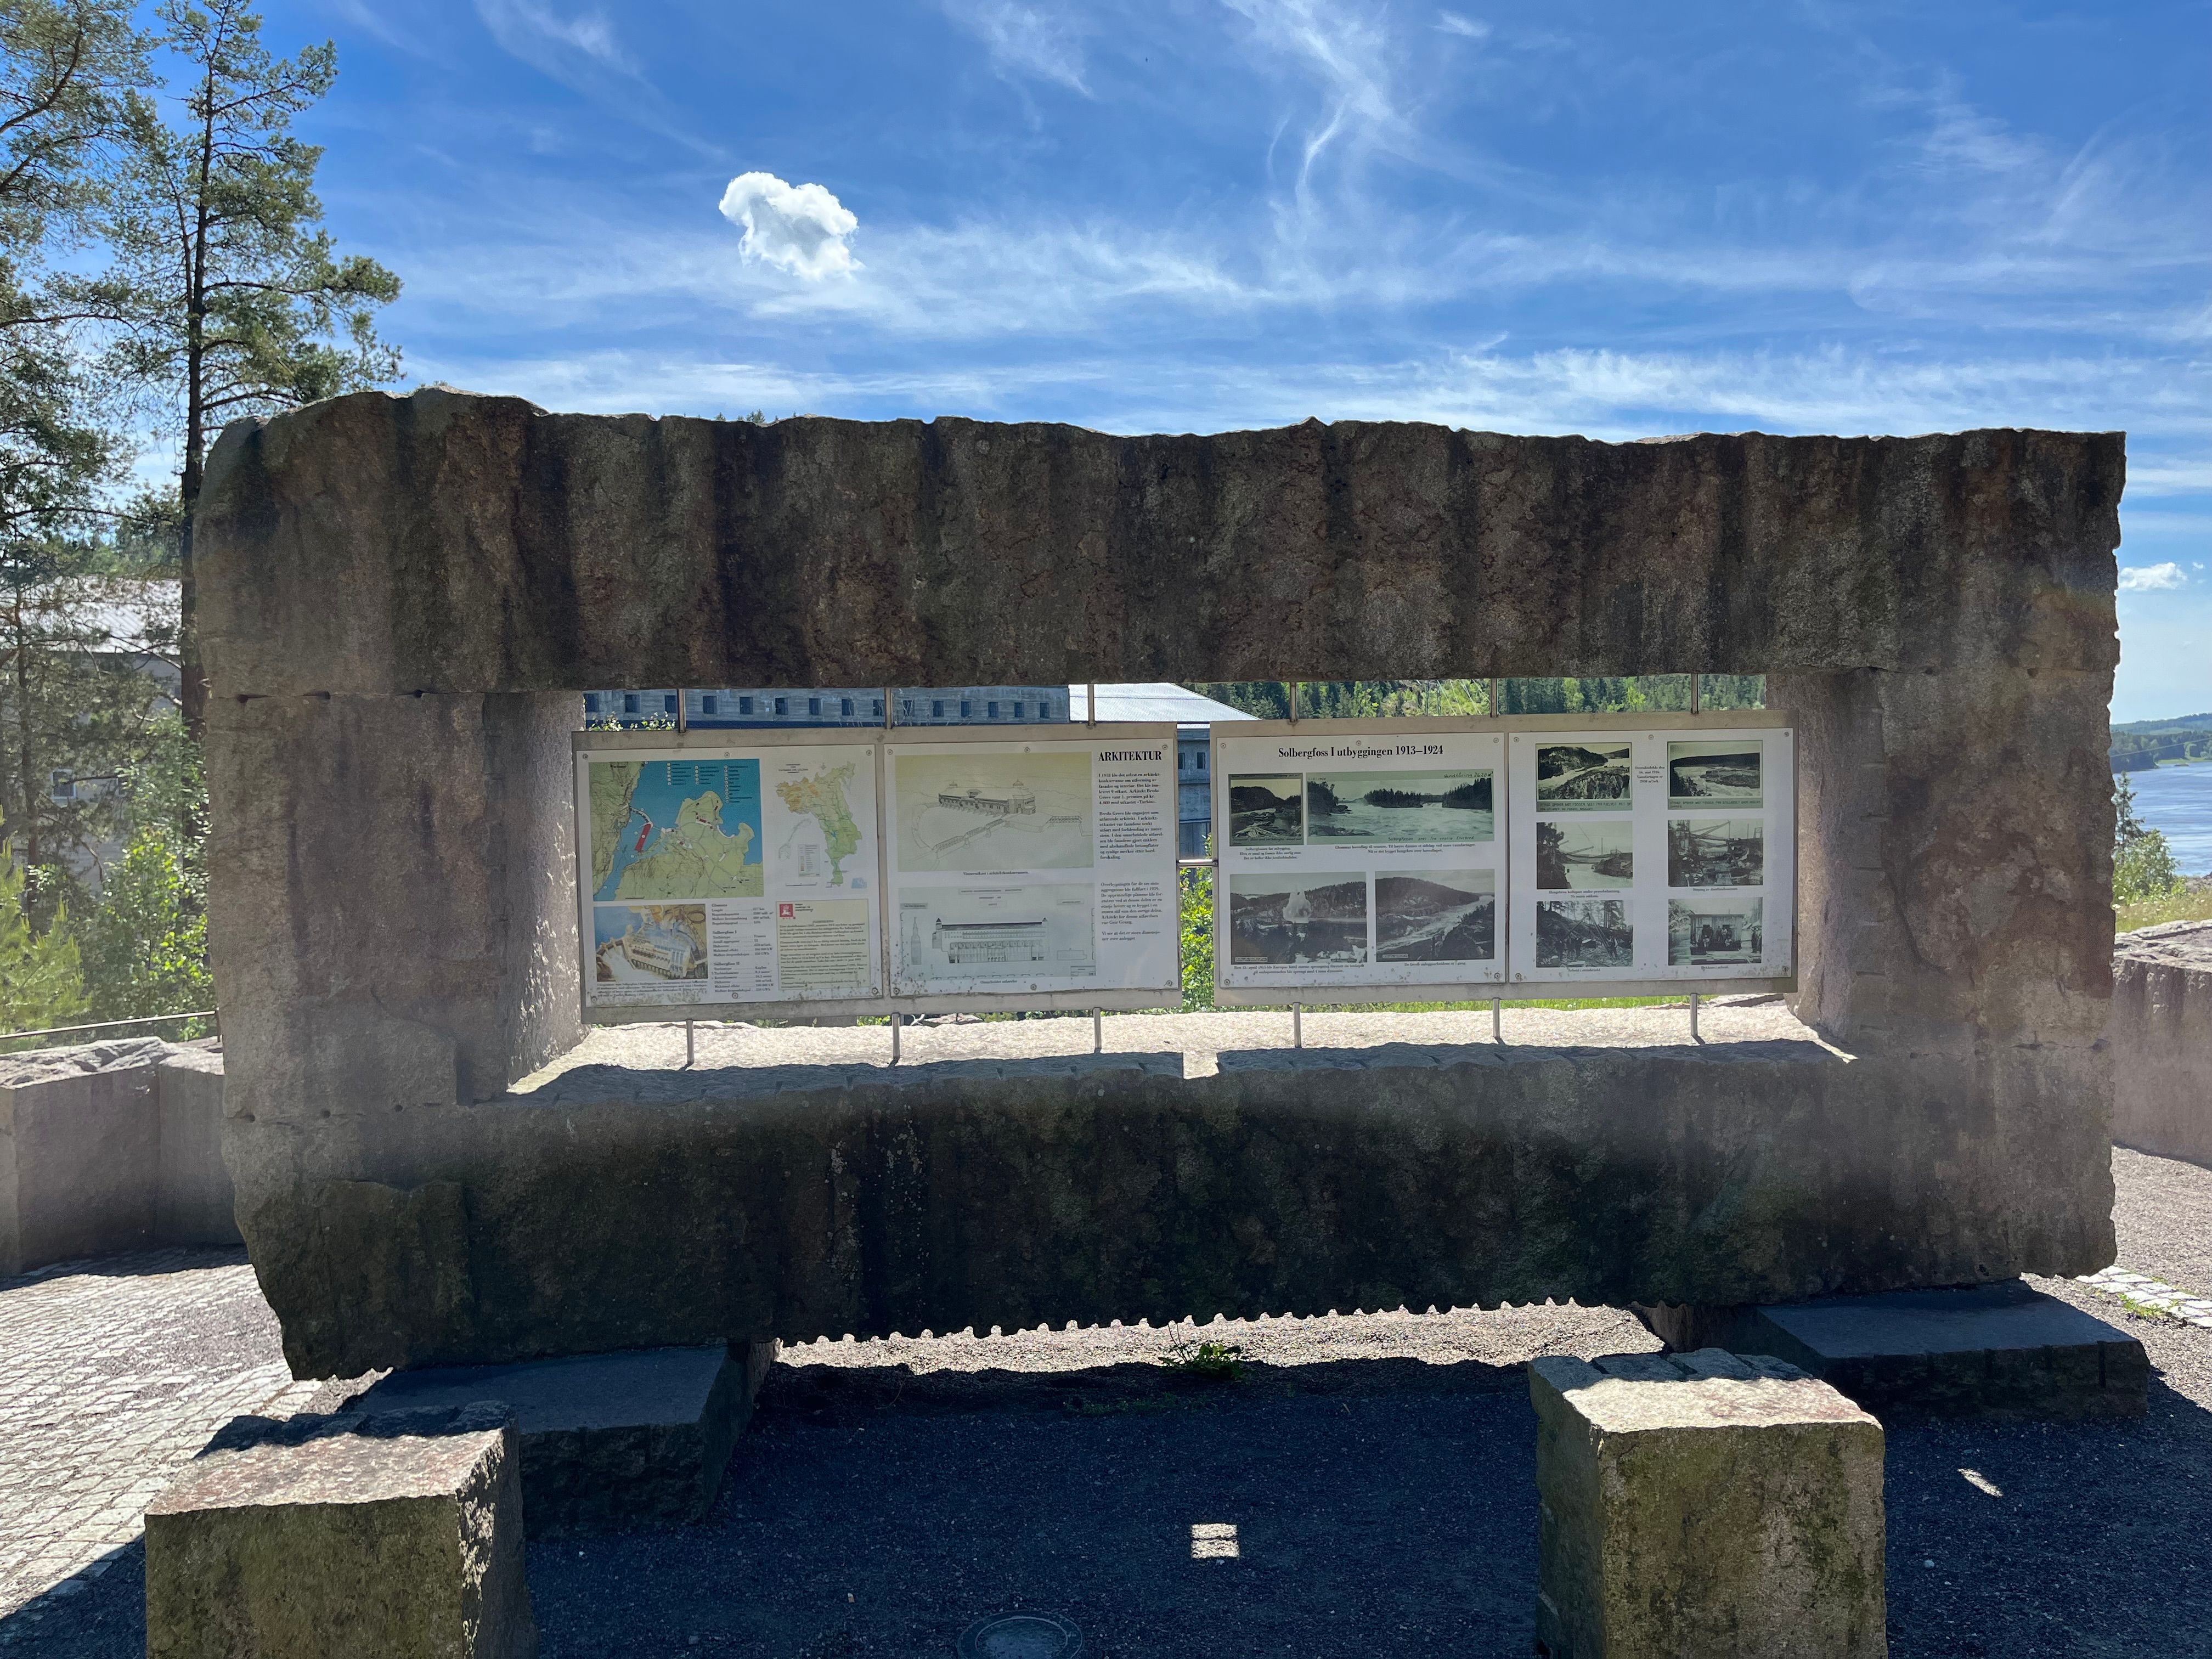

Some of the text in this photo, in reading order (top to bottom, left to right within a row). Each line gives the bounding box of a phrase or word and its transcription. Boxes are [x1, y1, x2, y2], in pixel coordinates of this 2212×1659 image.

[1098, 751, 1161, 761] ARKITEKTUR
[1279, 745, 1443, 759] Solbergfoss I utbyggingen 1913–1924
